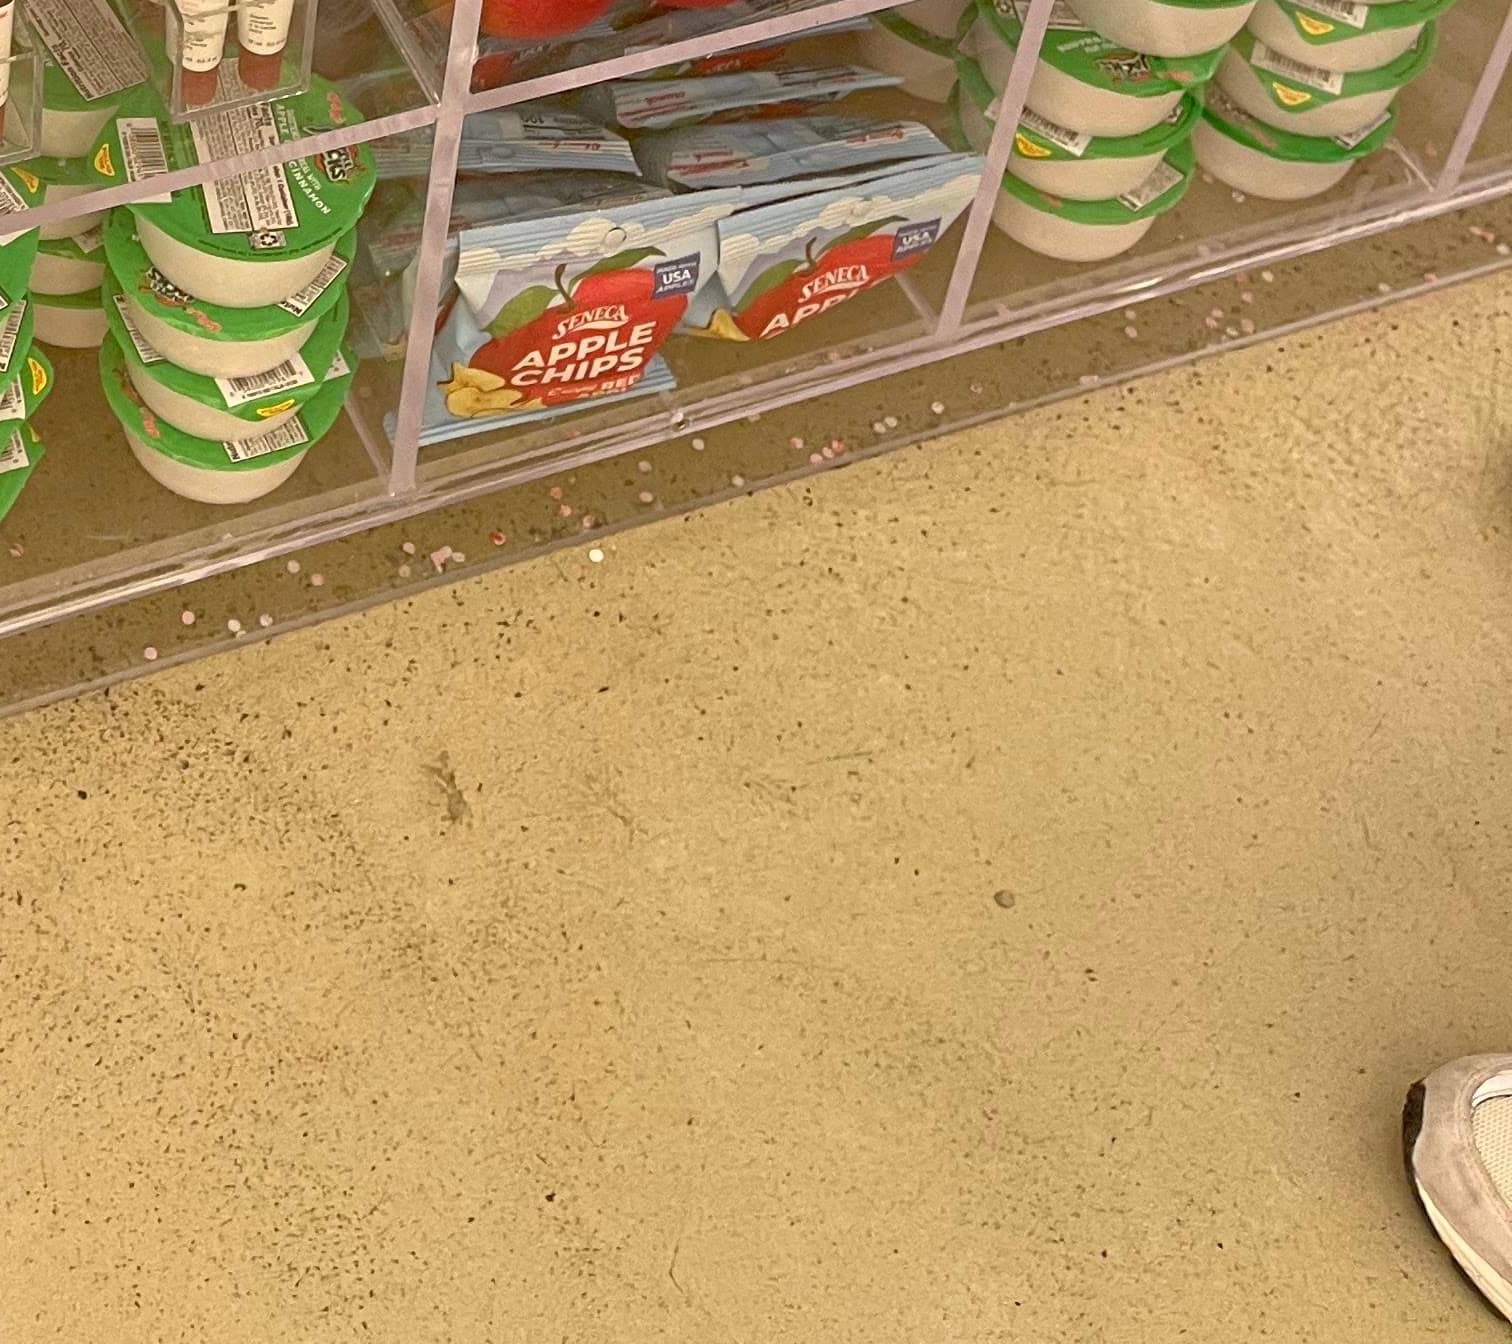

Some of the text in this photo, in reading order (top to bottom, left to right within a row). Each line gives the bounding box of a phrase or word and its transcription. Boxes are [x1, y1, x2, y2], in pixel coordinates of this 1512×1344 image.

[288, 160, 332, 216] CINNAMON
[901, 230, 932, 246] USA
[662, 268, 692, 285] USA
[796, 264, 871, 304] SENECA
[551, 303, 632, 341] SENECA
[511, 320, 658, 372] APPLE
[509, 346, 646, 387] CHIPS
